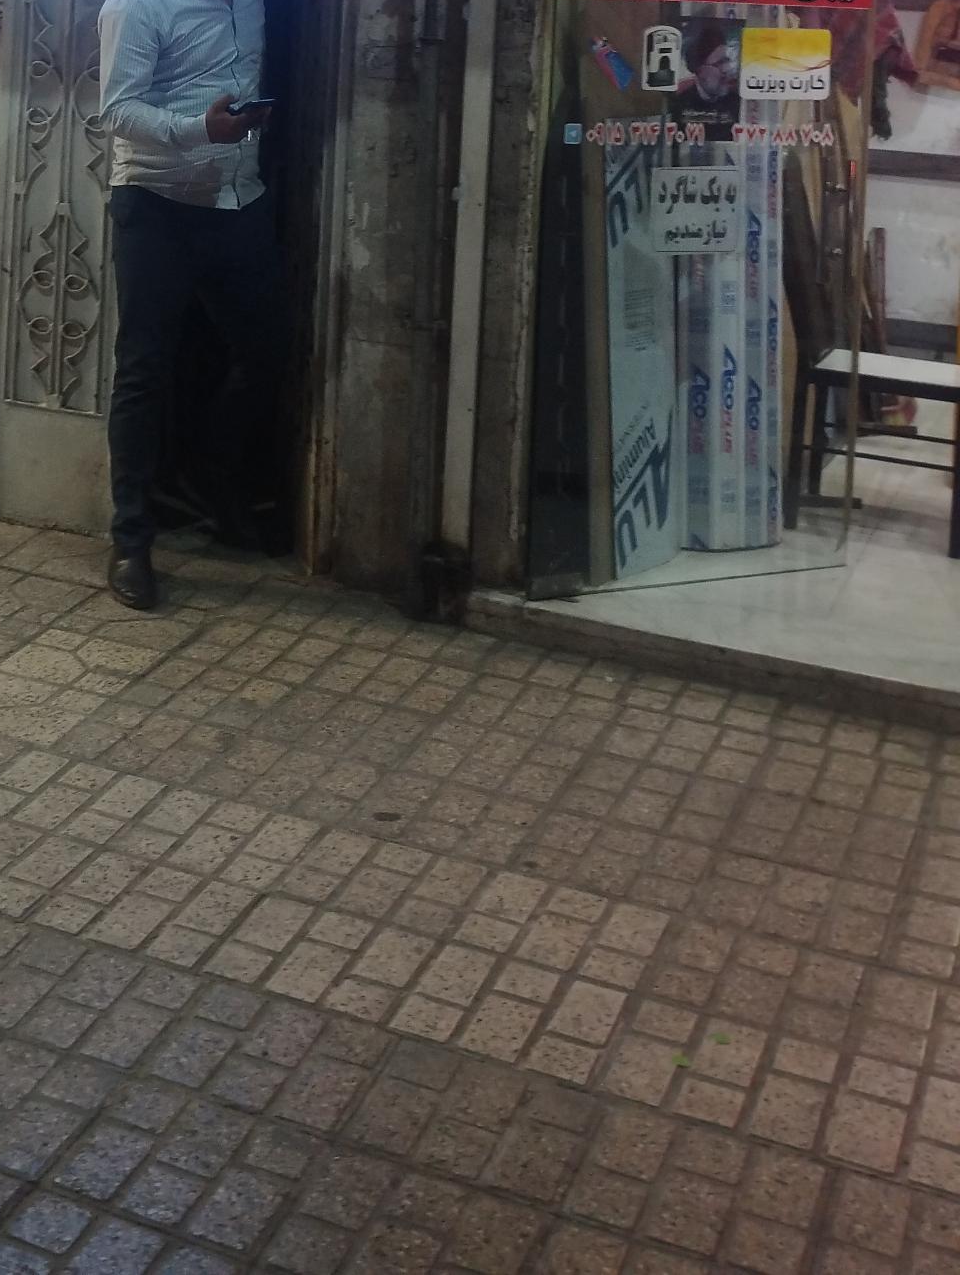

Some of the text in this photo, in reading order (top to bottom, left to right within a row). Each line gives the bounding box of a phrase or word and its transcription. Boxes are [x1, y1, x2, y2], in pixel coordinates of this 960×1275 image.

[746, 74, 825, 93] کارت ویزیت
[658, 175, 698, 214] شاگرد
